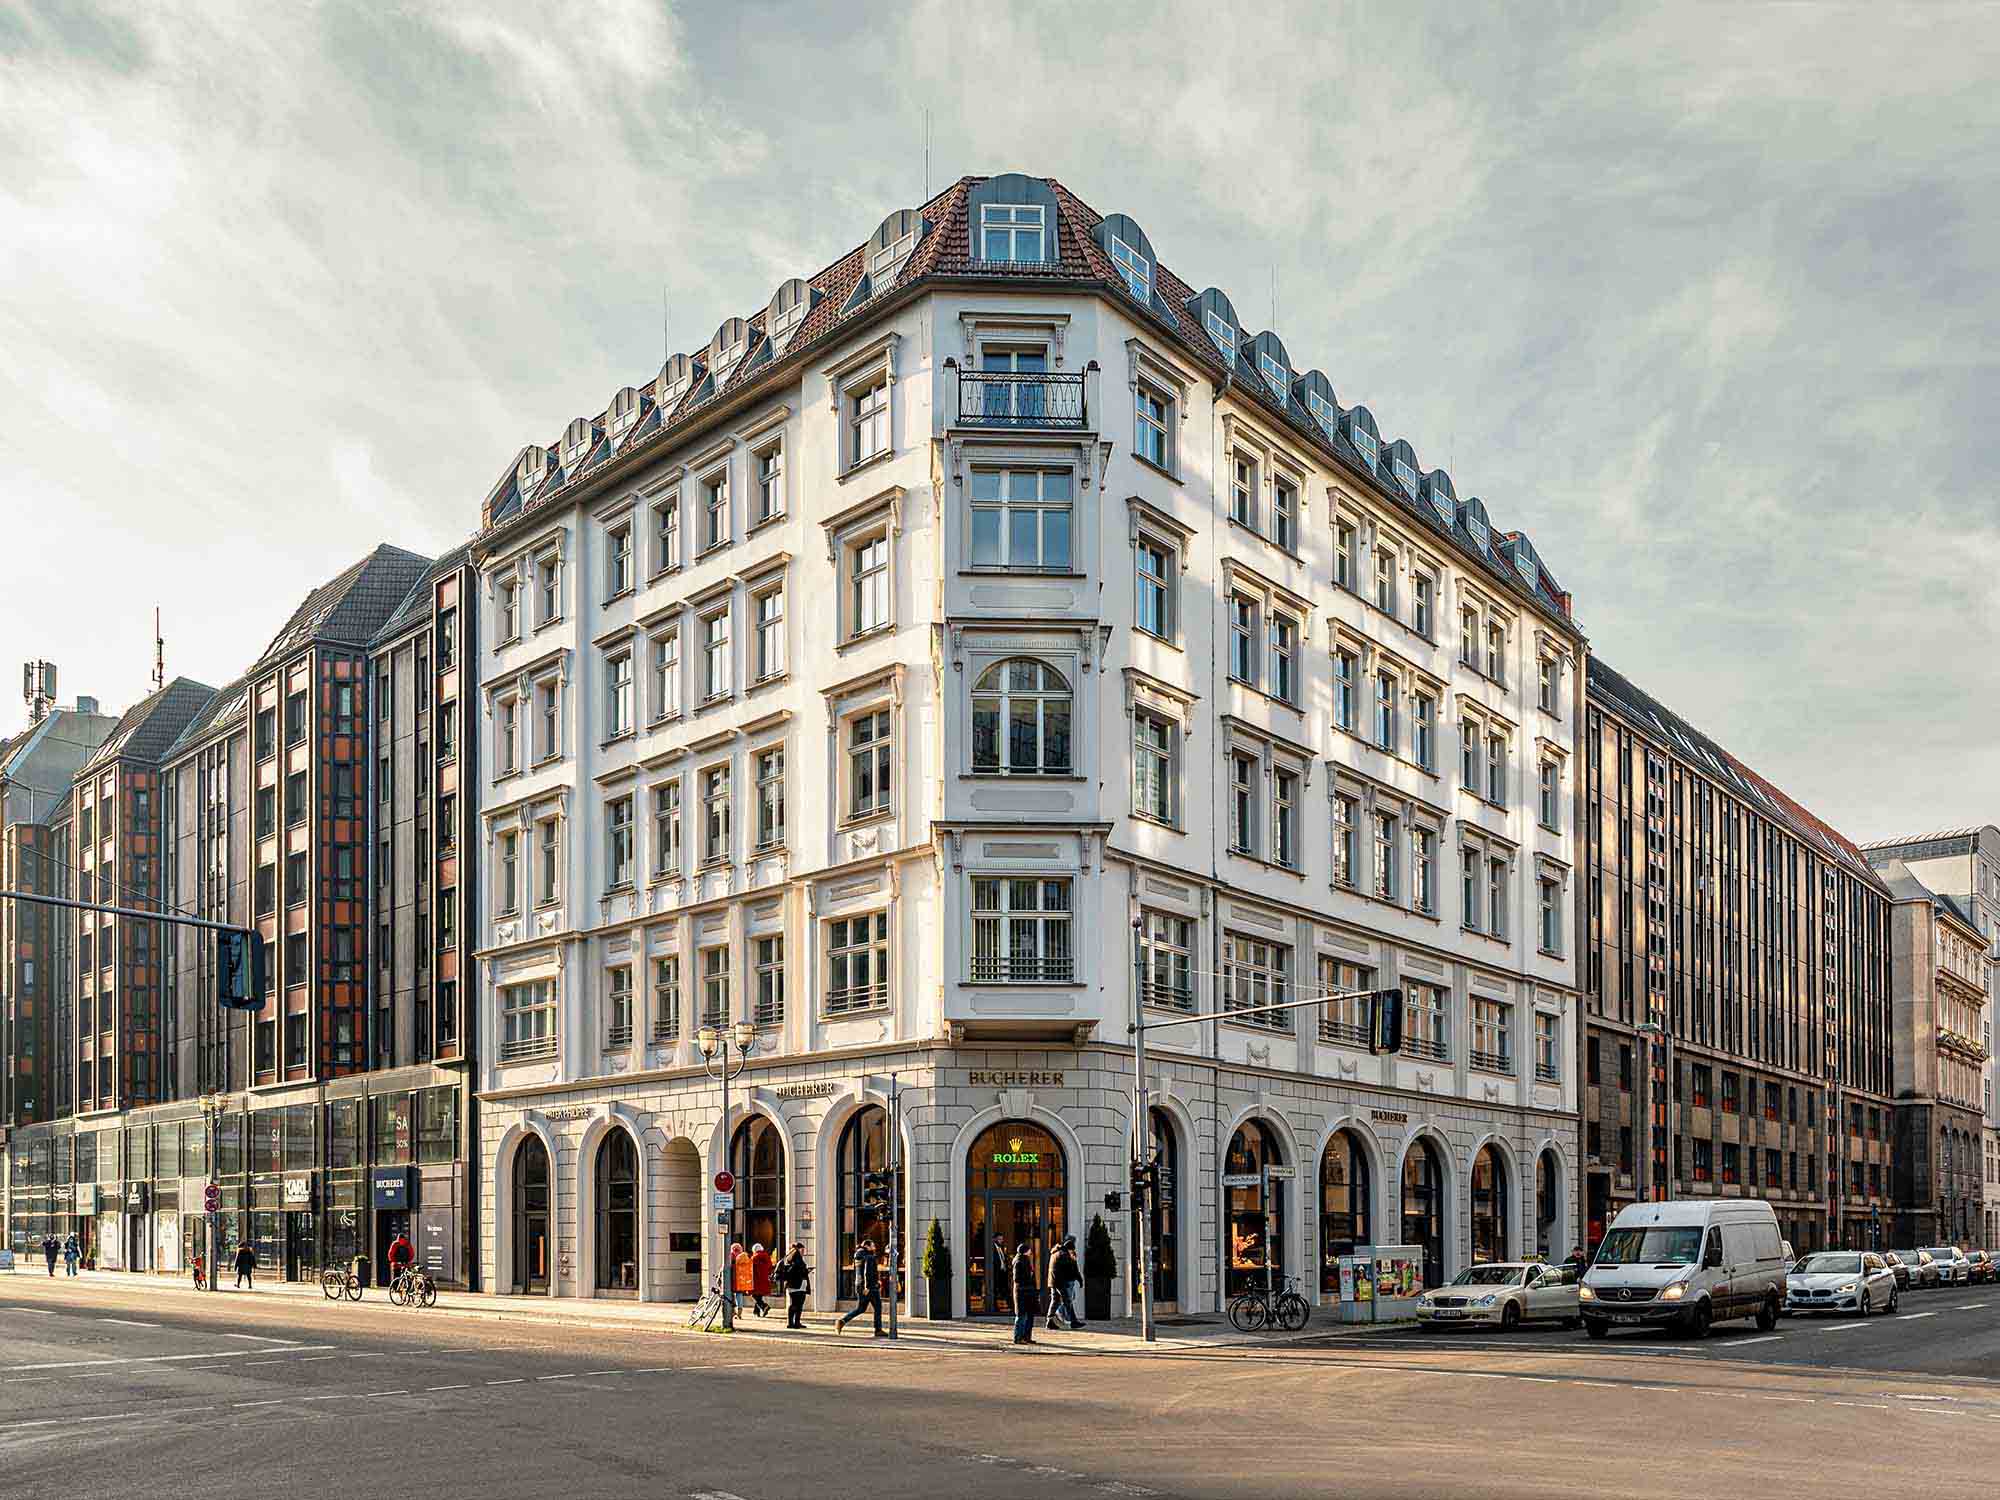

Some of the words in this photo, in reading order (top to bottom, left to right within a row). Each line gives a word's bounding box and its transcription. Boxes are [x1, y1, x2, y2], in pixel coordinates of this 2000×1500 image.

[969, 1071, 1064, 1085] BUCHERER
[776, 1081, 834, 1097] BUCHERER
[1371, 1110, 1408, 1122] BUCHERER
[993, 1153, 1039, 1163] ROLEX
[284, 1179, 310, 1195] KARL
[375, 1179, 404, 1188] BUCHERER
